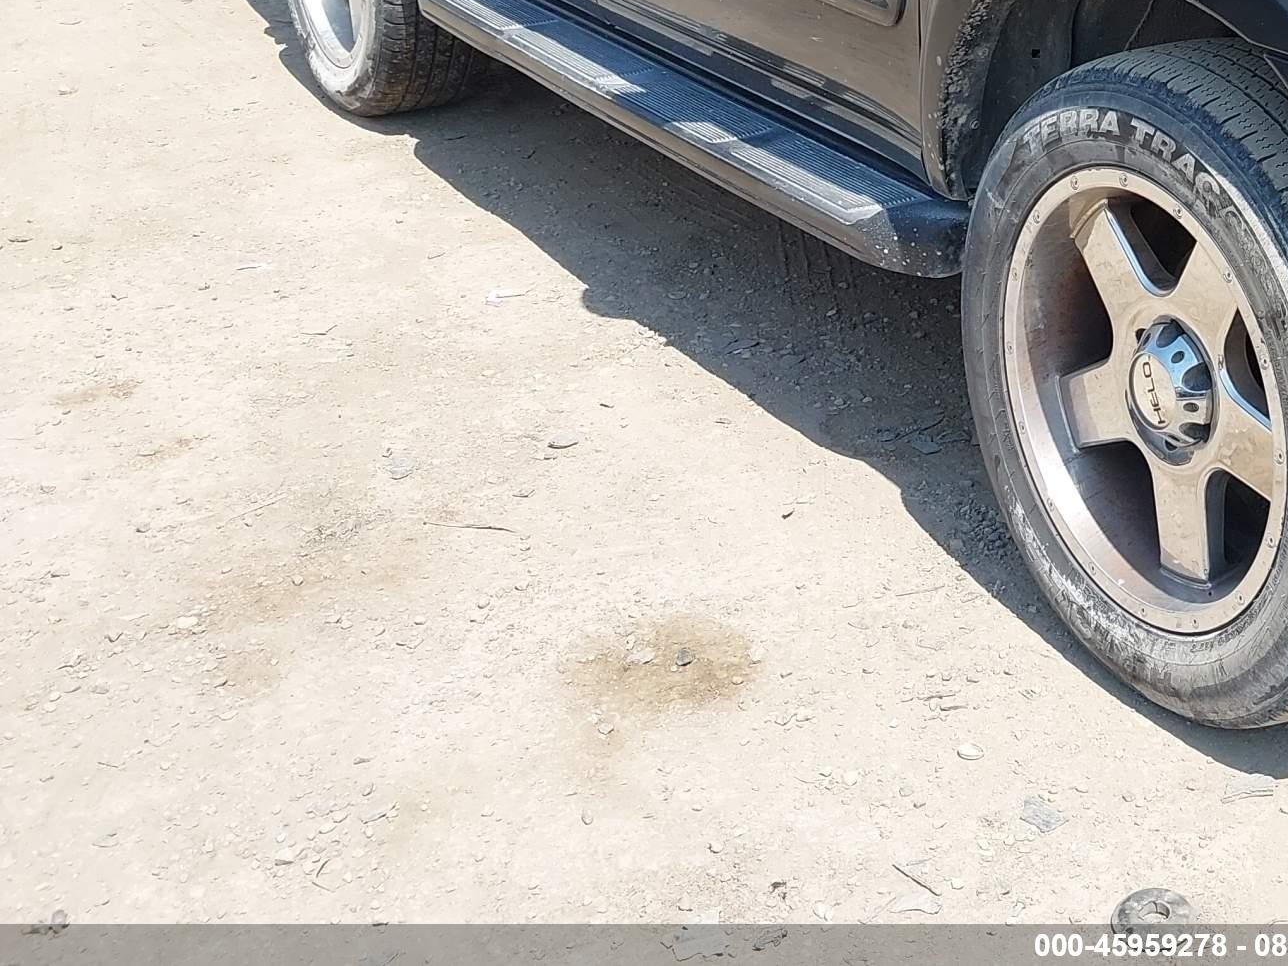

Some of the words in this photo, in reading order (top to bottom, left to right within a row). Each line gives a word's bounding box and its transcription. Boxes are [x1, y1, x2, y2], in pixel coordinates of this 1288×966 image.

[1022, 108, 1120, 155] TERRA
[1130, 117, 1222, 208] TRAC
[1142, 361, 1166, 424] HELO
